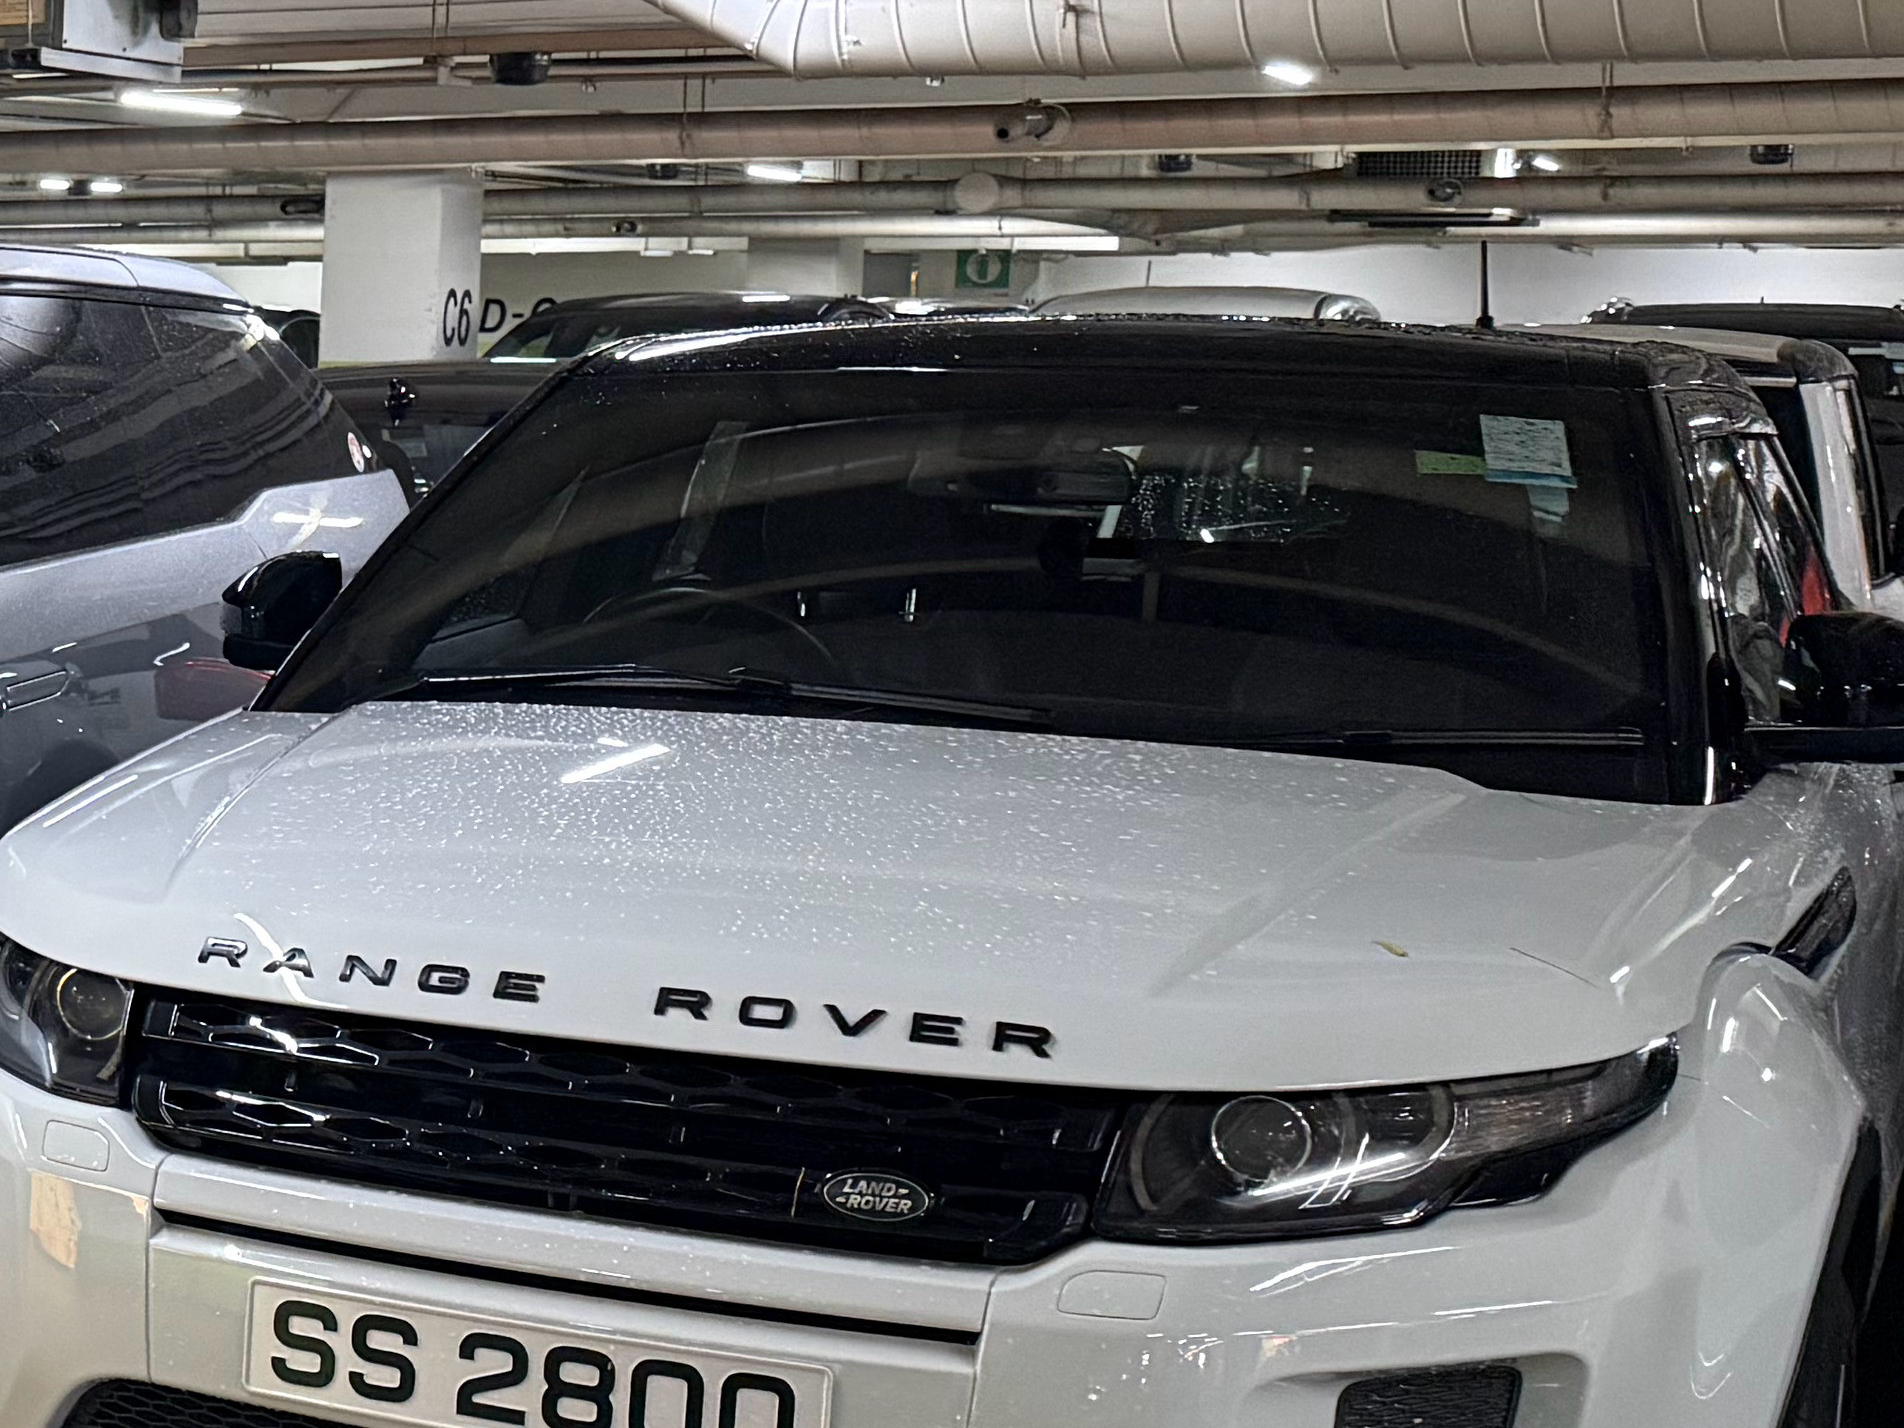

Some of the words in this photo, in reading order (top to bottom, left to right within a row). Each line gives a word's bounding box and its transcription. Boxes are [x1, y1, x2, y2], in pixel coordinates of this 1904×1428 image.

[442, 287, 473, 347] C6
[197, 936, 548, 1003] RANGE
[652, 985, 1053, 1060] ROVER
[270, 1298, 419, 1404] SS
